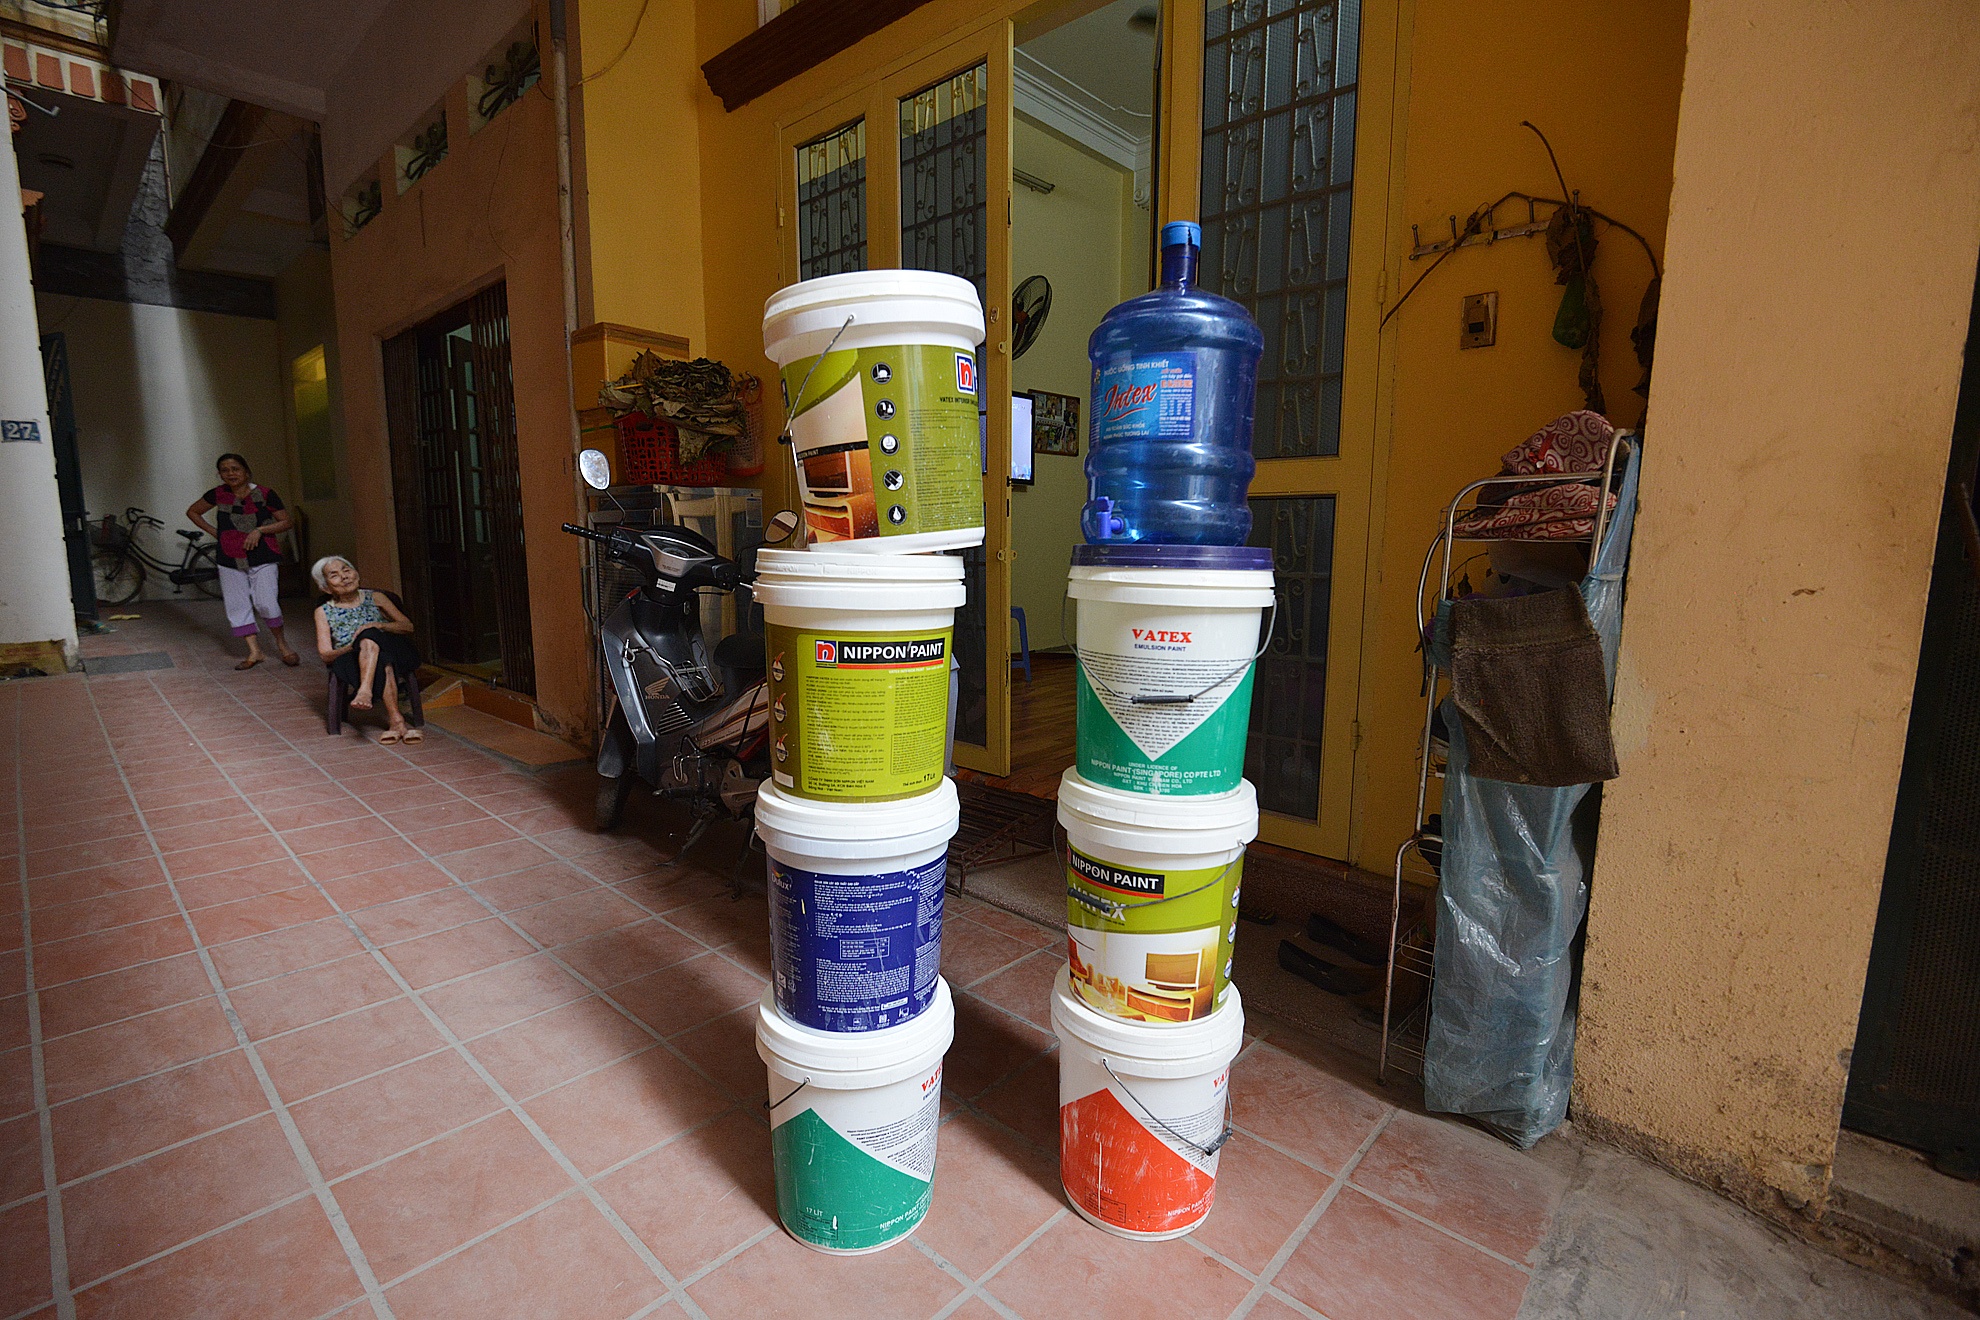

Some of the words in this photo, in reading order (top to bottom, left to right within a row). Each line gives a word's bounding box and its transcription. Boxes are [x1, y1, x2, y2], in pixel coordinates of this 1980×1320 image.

[5, 422, 32, 439] 27
[1131, 628, 1192, 643] VATEX
[843, 645, 906, 660] NIPPON
[910, 642, 943, 658] PAINT
[1134, 643, 1166, 651] EMULSION
[1091, 759, 1111, 770] NIPPON
[1112, 764, 1131, 773] PAINT
[1183, 770, 1195, 778] CO
[1195, 770, 1208, 778] PTE
[1072, 854, 1110, 882] NIPPON
[1113, 872, 1160, 890] PAINT
[771, 872, 790, 891] Dulux
[879, 1214, 904, 1230] NIPPON
[904, 1202, 919, 1218] PAINT
[1167, 1206, 1191, 1217] NIPPON
